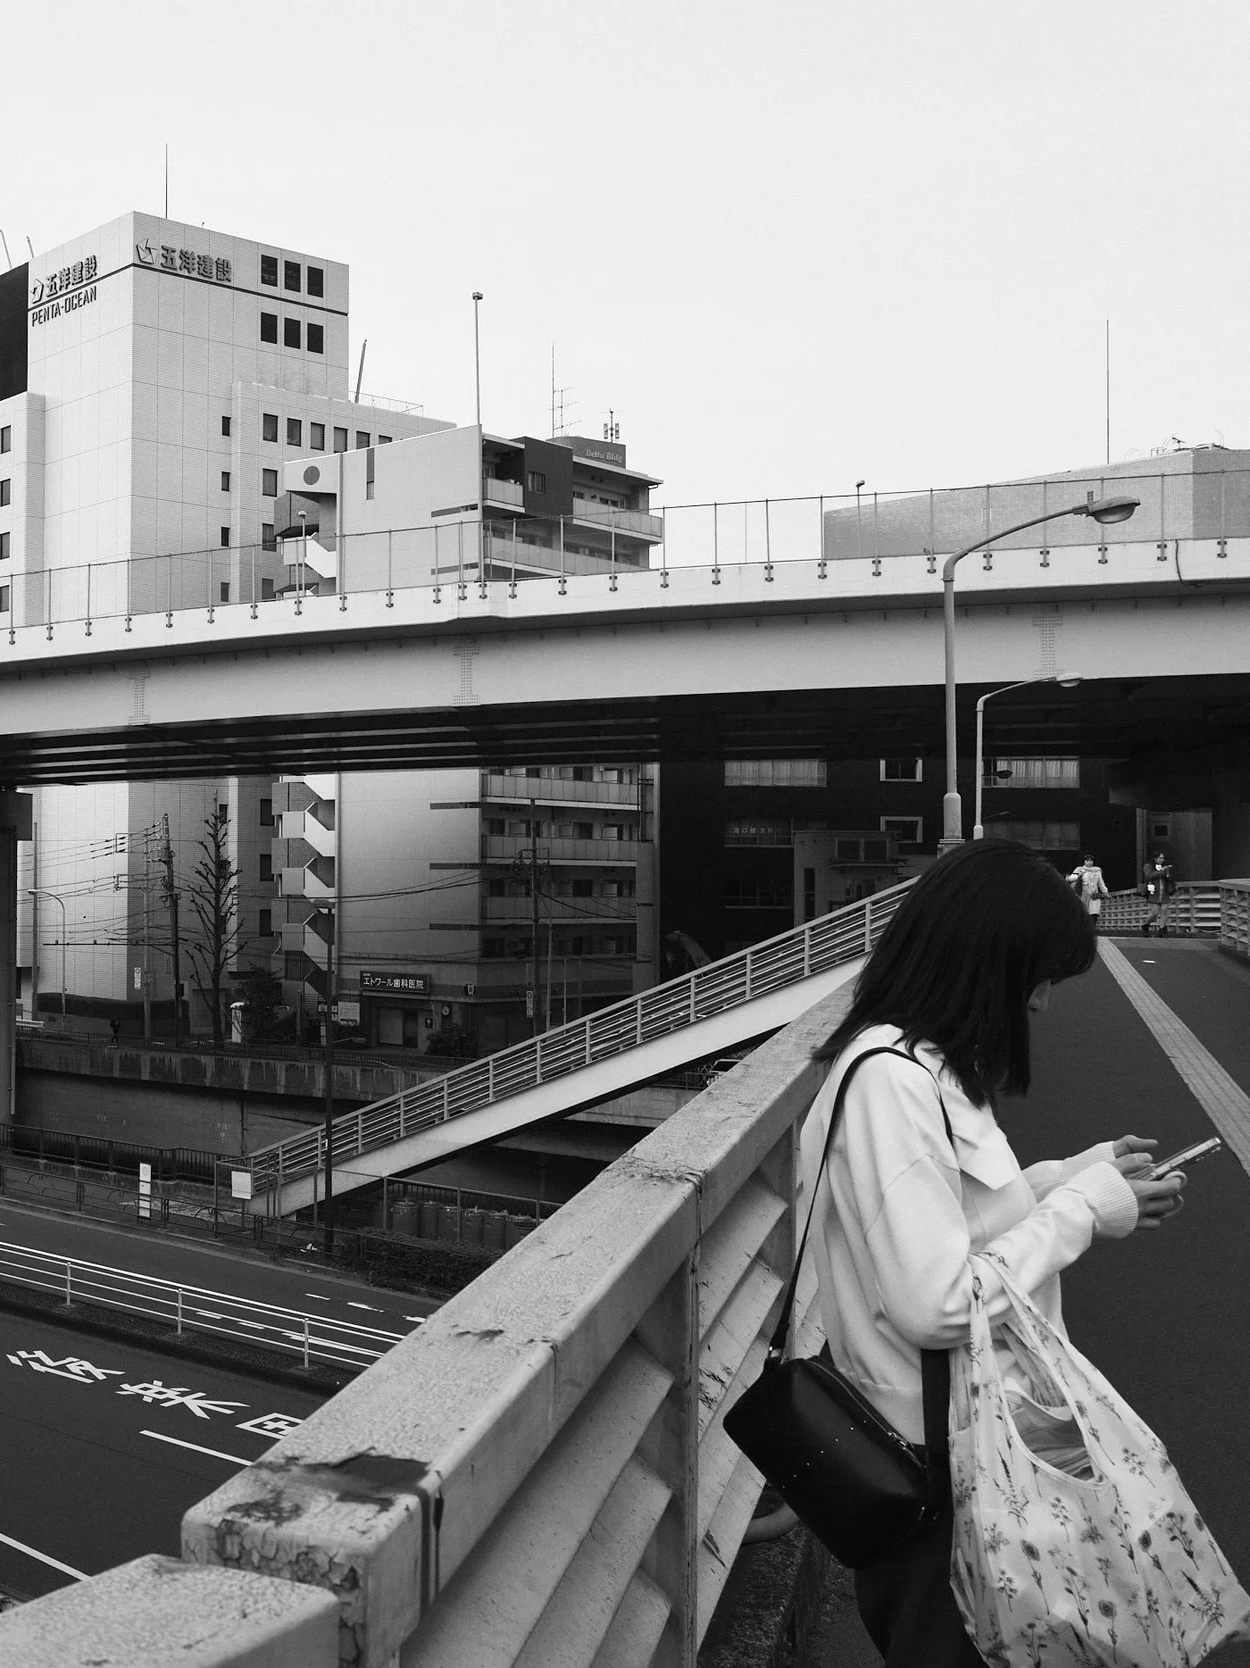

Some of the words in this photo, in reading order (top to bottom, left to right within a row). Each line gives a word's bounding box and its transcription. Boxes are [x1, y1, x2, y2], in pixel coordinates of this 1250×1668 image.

[45, 254, 98, 298] 五洋建設
[160, 244, 232, 283] 五洋建設
[32, 285, 97, 327] PENTA-OCEAN
[363, 976, 424, 990] エトワール歯科医院
